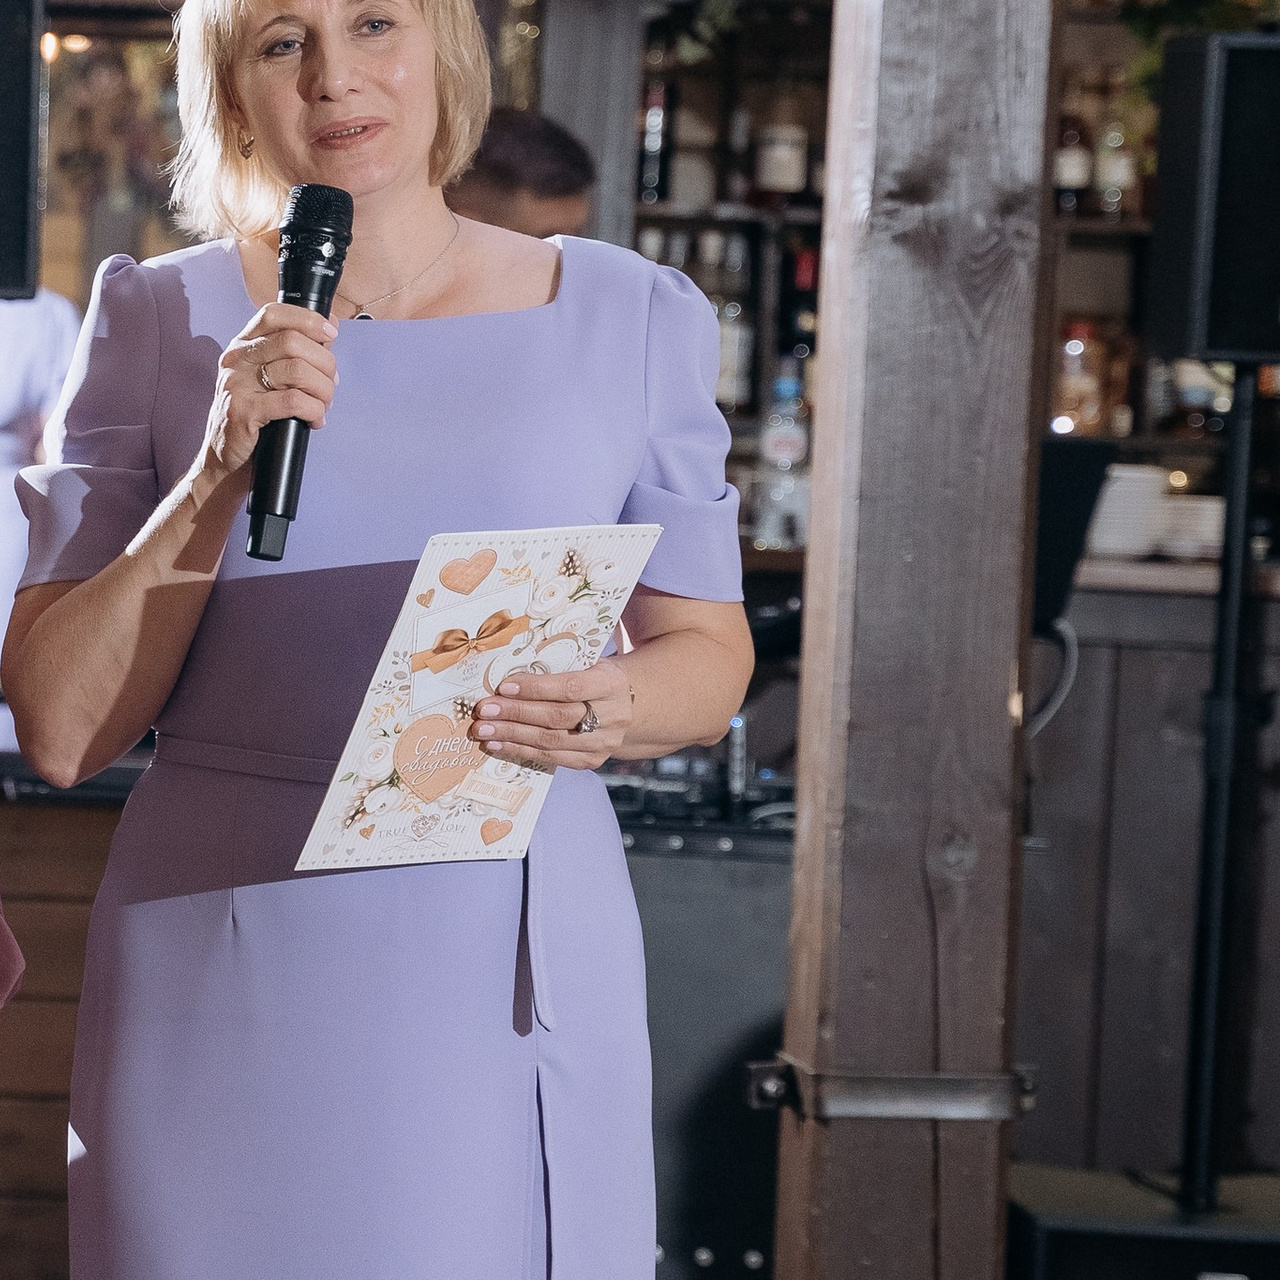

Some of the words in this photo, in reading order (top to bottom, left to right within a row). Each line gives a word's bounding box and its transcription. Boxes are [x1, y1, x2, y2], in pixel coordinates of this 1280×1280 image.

[466, 779, 502, 798] WEDDING
[379, 827, 407, 838] TRUE
[440, 822, 468, 834] LOVE
